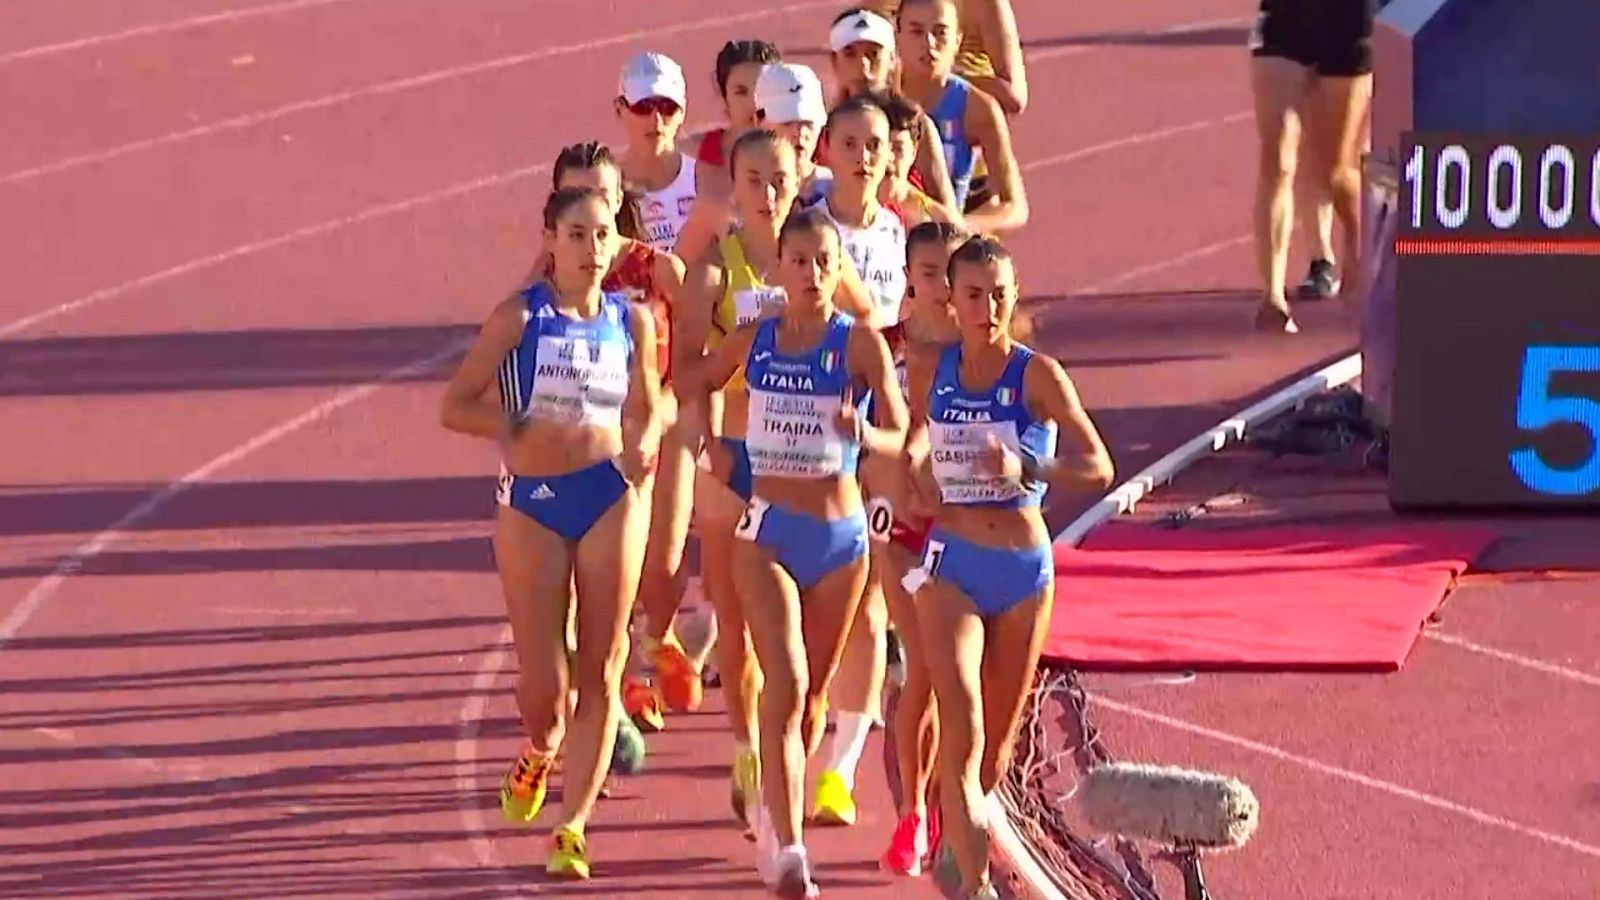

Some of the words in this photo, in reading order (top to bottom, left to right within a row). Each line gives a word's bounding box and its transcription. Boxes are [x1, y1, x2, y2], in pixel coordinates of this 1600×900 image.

[761, 373, 814, 391] ITALIA
[943, 409, 992, 421] ITALIA
[1508, 346, 1600, 495] 5
[762, 418, 824, 436] TRAINA
